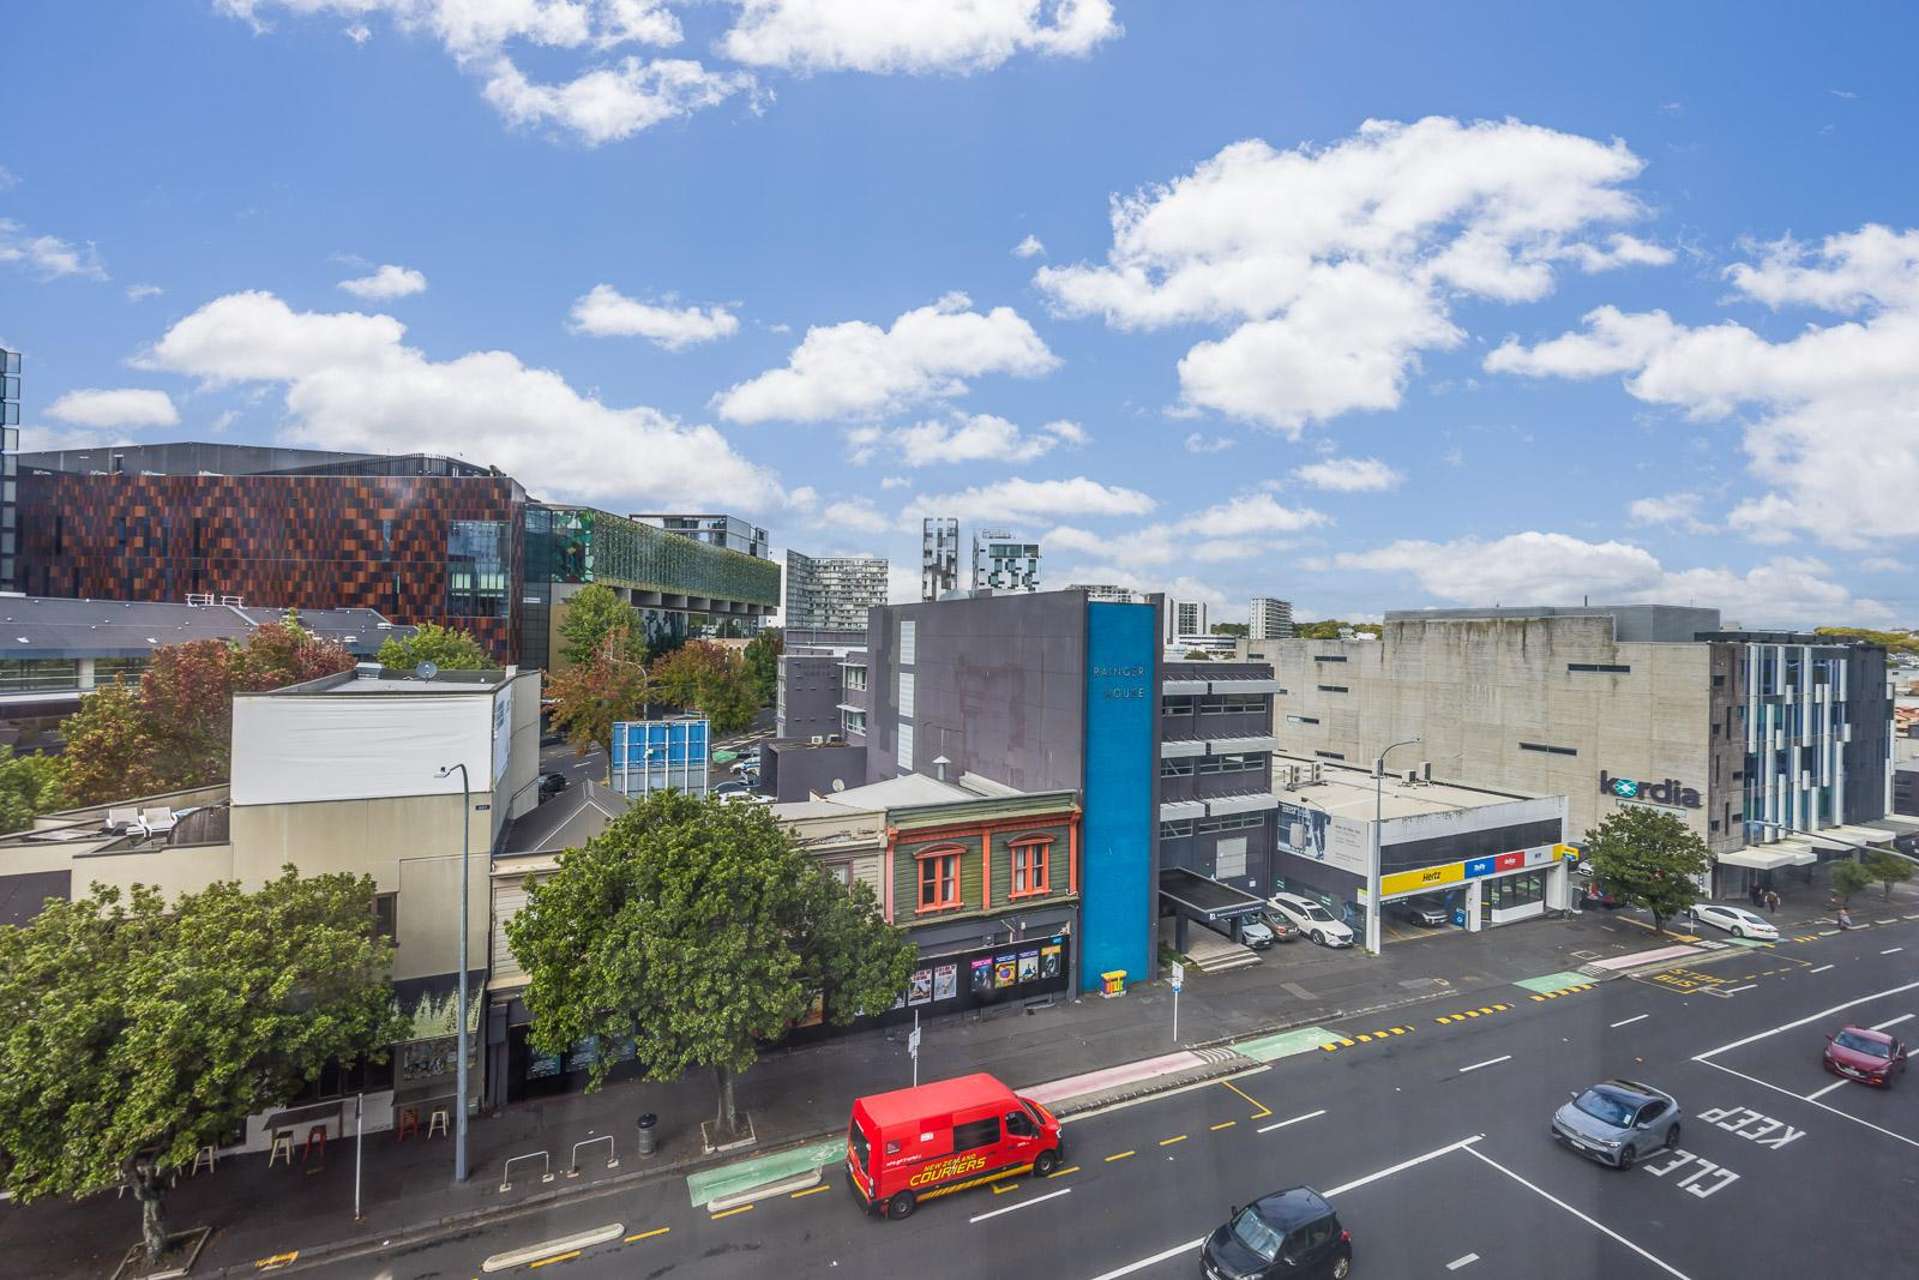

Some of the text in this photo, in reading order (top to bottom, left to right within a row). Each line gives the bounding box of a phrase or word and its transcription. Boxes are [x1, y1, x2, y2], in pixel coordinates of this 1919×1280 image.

[1104, 687, 1144, 698] OUE
[1696, 1106, 1807, 1150] KEEP
[910, 1156, 987, 1186] COURIERS
[1633, 1147, 1741, 1199] CLE
